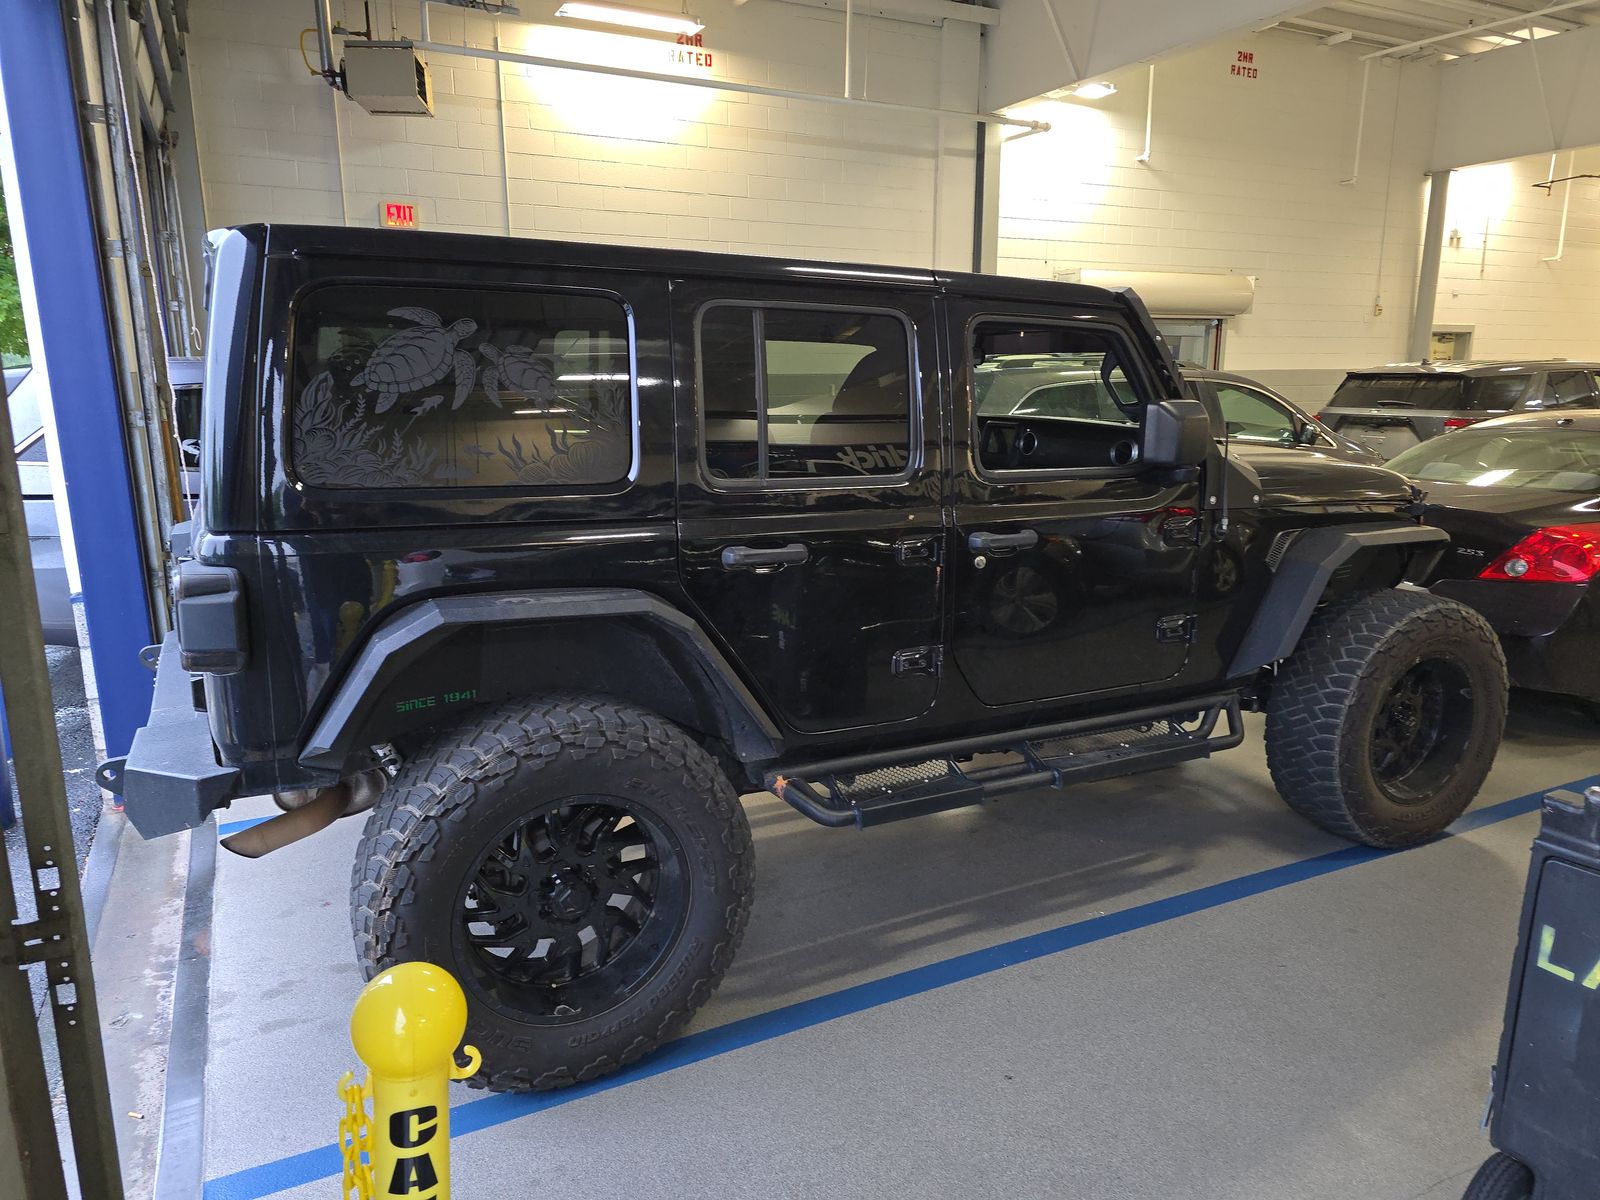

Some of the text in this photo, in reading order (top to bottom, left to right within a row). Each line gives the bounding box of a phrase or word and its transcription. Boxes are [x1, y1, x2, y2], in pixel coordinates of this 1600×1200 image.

[667, 50, 712, 67] RATED
[1237, 50, 1253, 63] 2HR
[1230, 64, 1258, 79] RATED
[386, 203, 414, 227] EXIT
[443, 689, 478, 703] 1941
[387, 1105, 439, 1200] CA
